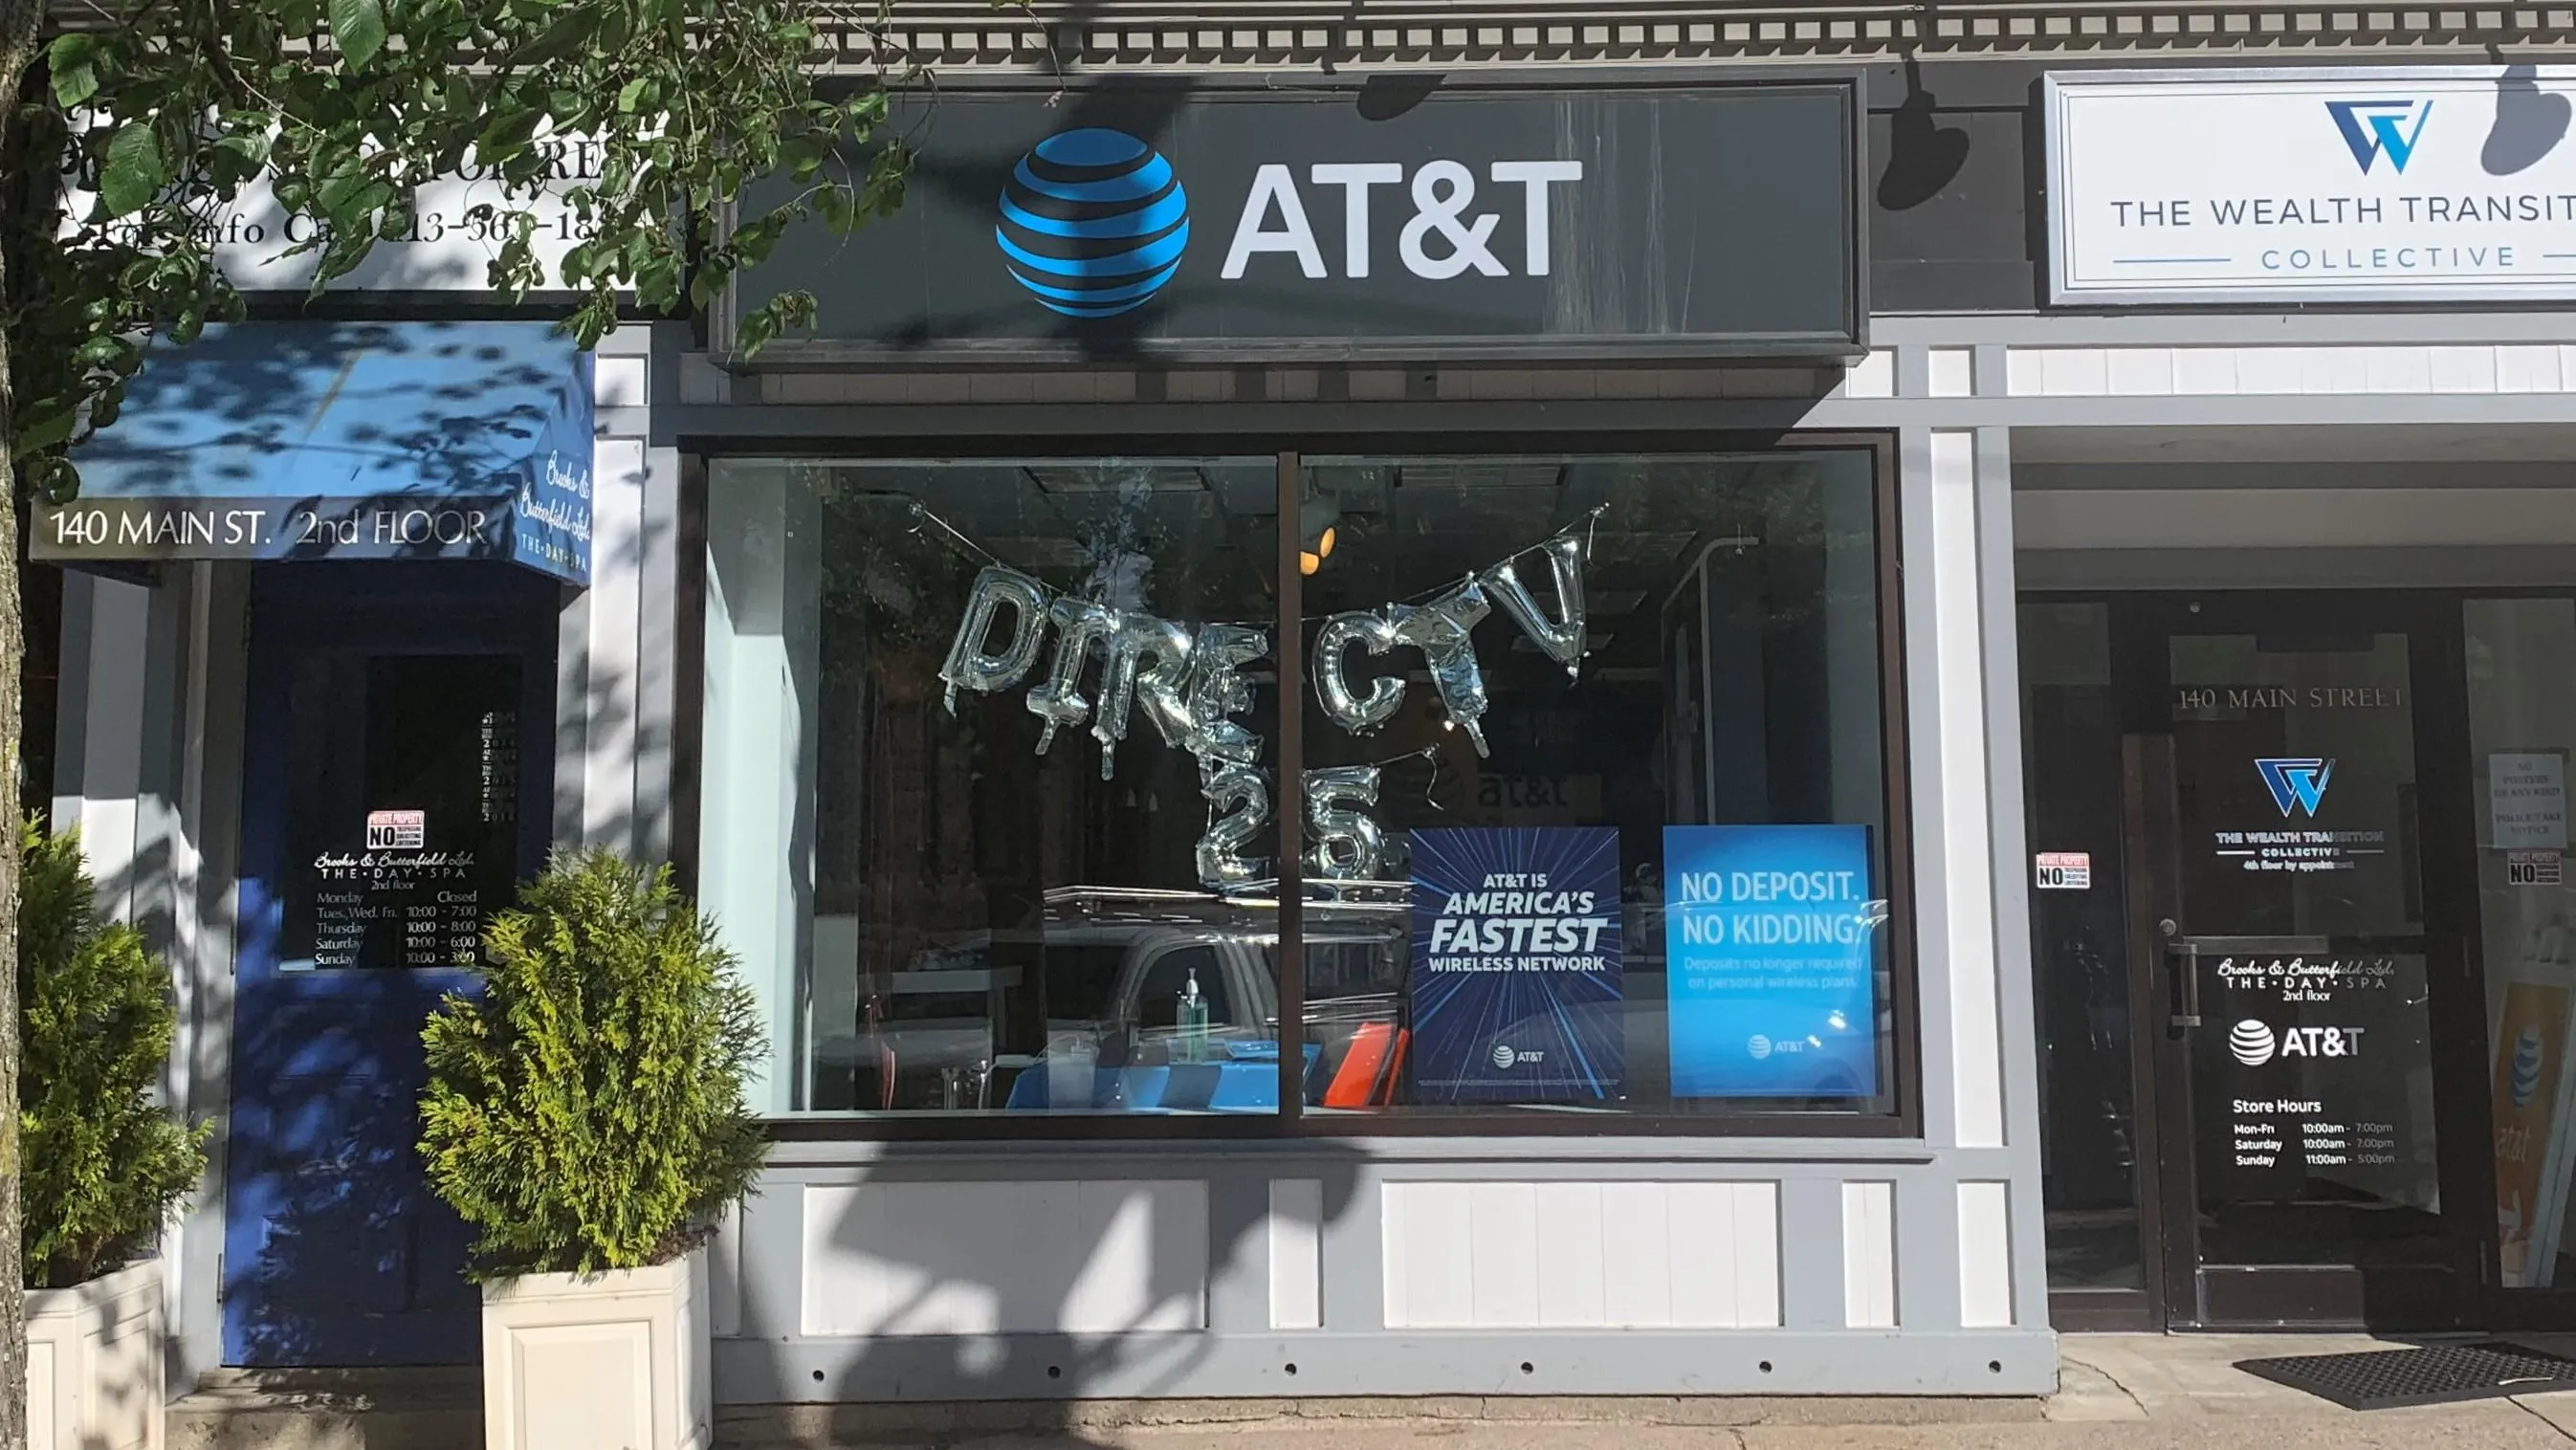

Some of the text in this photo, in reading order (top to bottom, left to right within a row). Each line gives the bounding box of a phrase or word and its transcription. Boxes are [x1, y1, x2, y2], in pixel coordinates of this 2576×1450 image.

[2110, 194, 2576, 227] THE WEALTH TRANSIT
[190, 212, 265, 243] nfo
[1221, 160, 1583, 279] AT&T
[2260, 246, 2515, 270] COLLECTIVE
[49, 509, 488, 546] 140 MAIN ST. 2nd FLOOR
[2180, 687, 2403, 709] 140 MAIN STREET
[369, 826, 395, 846] NO
[2215, 832, 2243, 844] THE
[2245, 831, 2301, 844] WEALTH
[314, 851, 358, 868] Brooks
[360, 852, 375, 868] &
[377, 850, 448, 869] Butterfield
[2261, 847, 2341, 857] COLLECTIVE
[1483, 873, 1548, 889] AT&T IS
[2039, 868, 2063, 886] NO
[2510, 864, 2536, 883] NO
[370, 880, 416, 890] 2nd floor
[1682, 871, 1860, 902] NO DEPOSIT.
[317, 890, 477, 907] Monday Closed
[1442, 890, 1596, 915] AMERICA'S
[406, 906, 437, 918] 10:00
[451, 906, 477, 917] 7:00
[317, 922, 367, 936] Thursday
[407, 921, 436, 933] 10:00
[451, 921, 476, 932] 8:00
[1429, 917, 1609, 954] FASTEST
[1684, 914, 1725, 945] NO
[315, 937, 363, 952] Saturday
[406, 936, 436, 948] 10:00
[451, 935, 476, 948] 6:00
[315, 953, 356, 967] Sunday
[406, 952, 436, 964] 10:00
[1428, 956, 1606, 972] WIRELESS NETWORK
[1684, 956, 1862, 973] Deposits no longer required
[2217, 957, 2266, 977] Brooks
[2268, 959, 2284, 977] &
[2287, 957, 2364, 980] Butterfield
[1688, 978, 1706, 989] on
[1708, 976, 1764, 991] personal
[1766, 976, 1819, 988] wireless
[2282, 990, 2332, 1001] 2nd floor
[1775, 1041, 1804, 1053] AT&T
[2281, 1026, 2366, 1057] AT&T
[1517, 1050, 1544, 1063] AT&T
[2233, 1099, 2323, 1113] Store Hours
[2234, 1123, 2276, 1135] Mon-Fri
[2301, 1123, 2345, 1134] 10:00am
[2356, 1122, 2393, 1135] 7:00pm
[2235, 1138, 2283, 1153] Saturday
[2302, 1138, 2345, 1149] 10:00am
[2357, 1137, 2394, 1152] 7:00pm
[2235, 1154, 2276, 1168] Sunday
[2305, 1153, 2346, 1165] 11:00am
